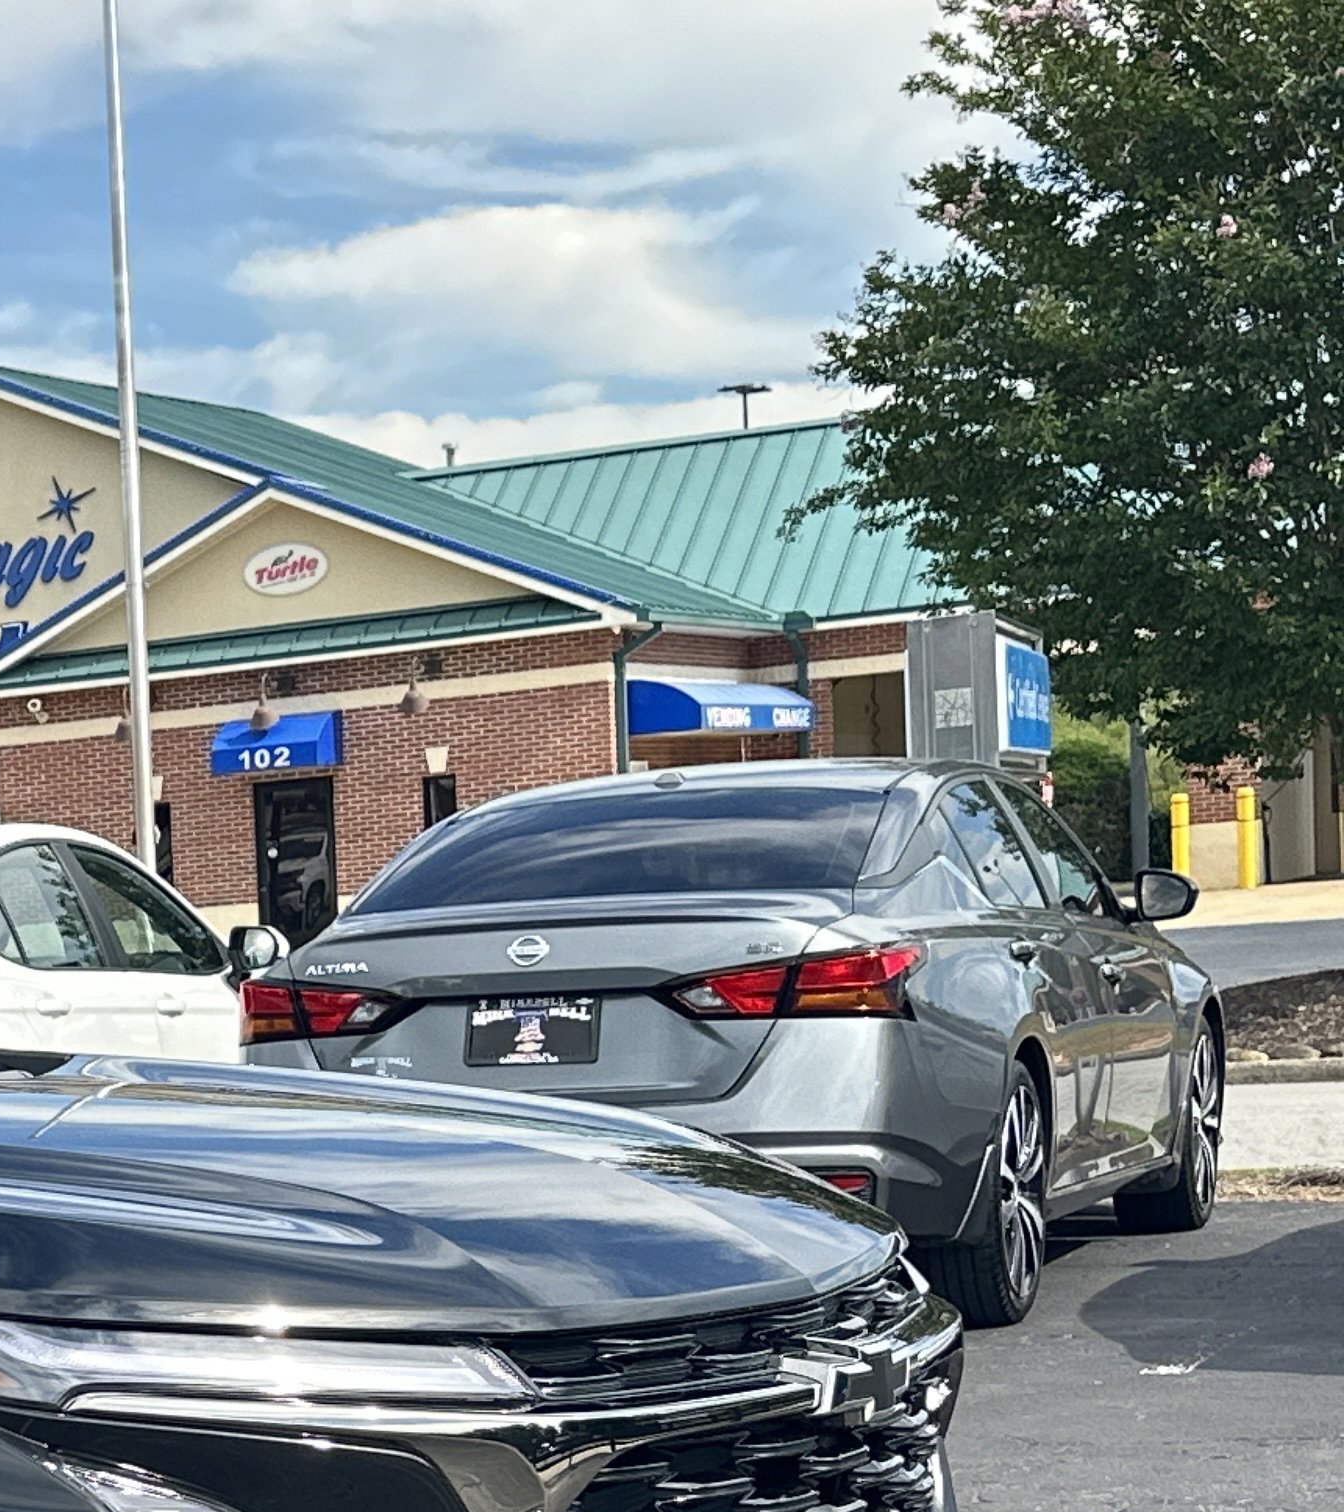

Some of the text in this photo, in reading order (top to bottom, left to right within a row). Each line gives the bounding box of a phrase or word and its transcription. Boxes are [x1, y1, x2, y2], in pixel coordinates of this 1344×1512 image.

[255, 554, 319, 585] Turtle
[238, 746, 291, 770] 102
[305, 961, 369, 977] ALTIMA
